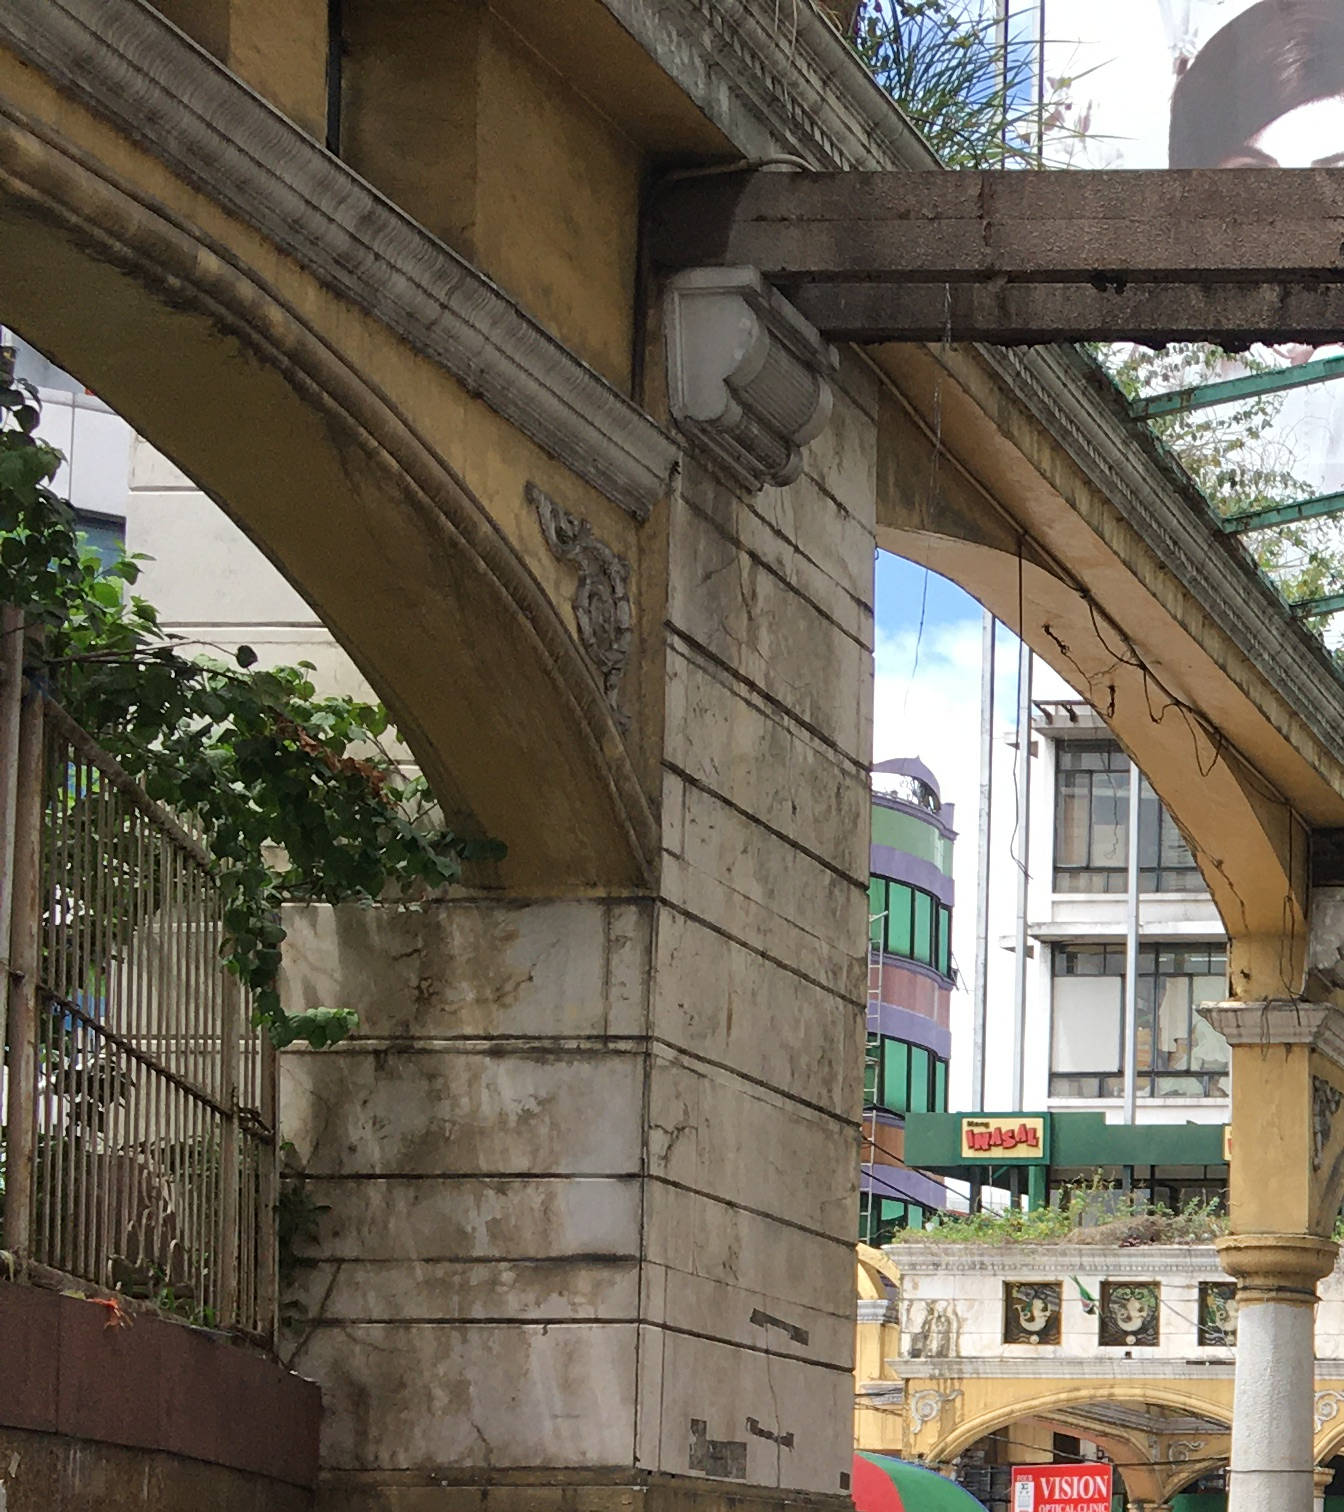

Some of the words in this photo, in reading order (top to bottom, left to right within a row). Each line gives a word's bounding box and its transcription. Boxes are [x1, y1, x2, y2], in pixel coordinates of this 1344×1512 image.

[965, 1123, 1039, 1151] INASAL
[1040, 1475, 1108, 1499] VISION
[1078, 1503, 1108, 1512] CLINIC
